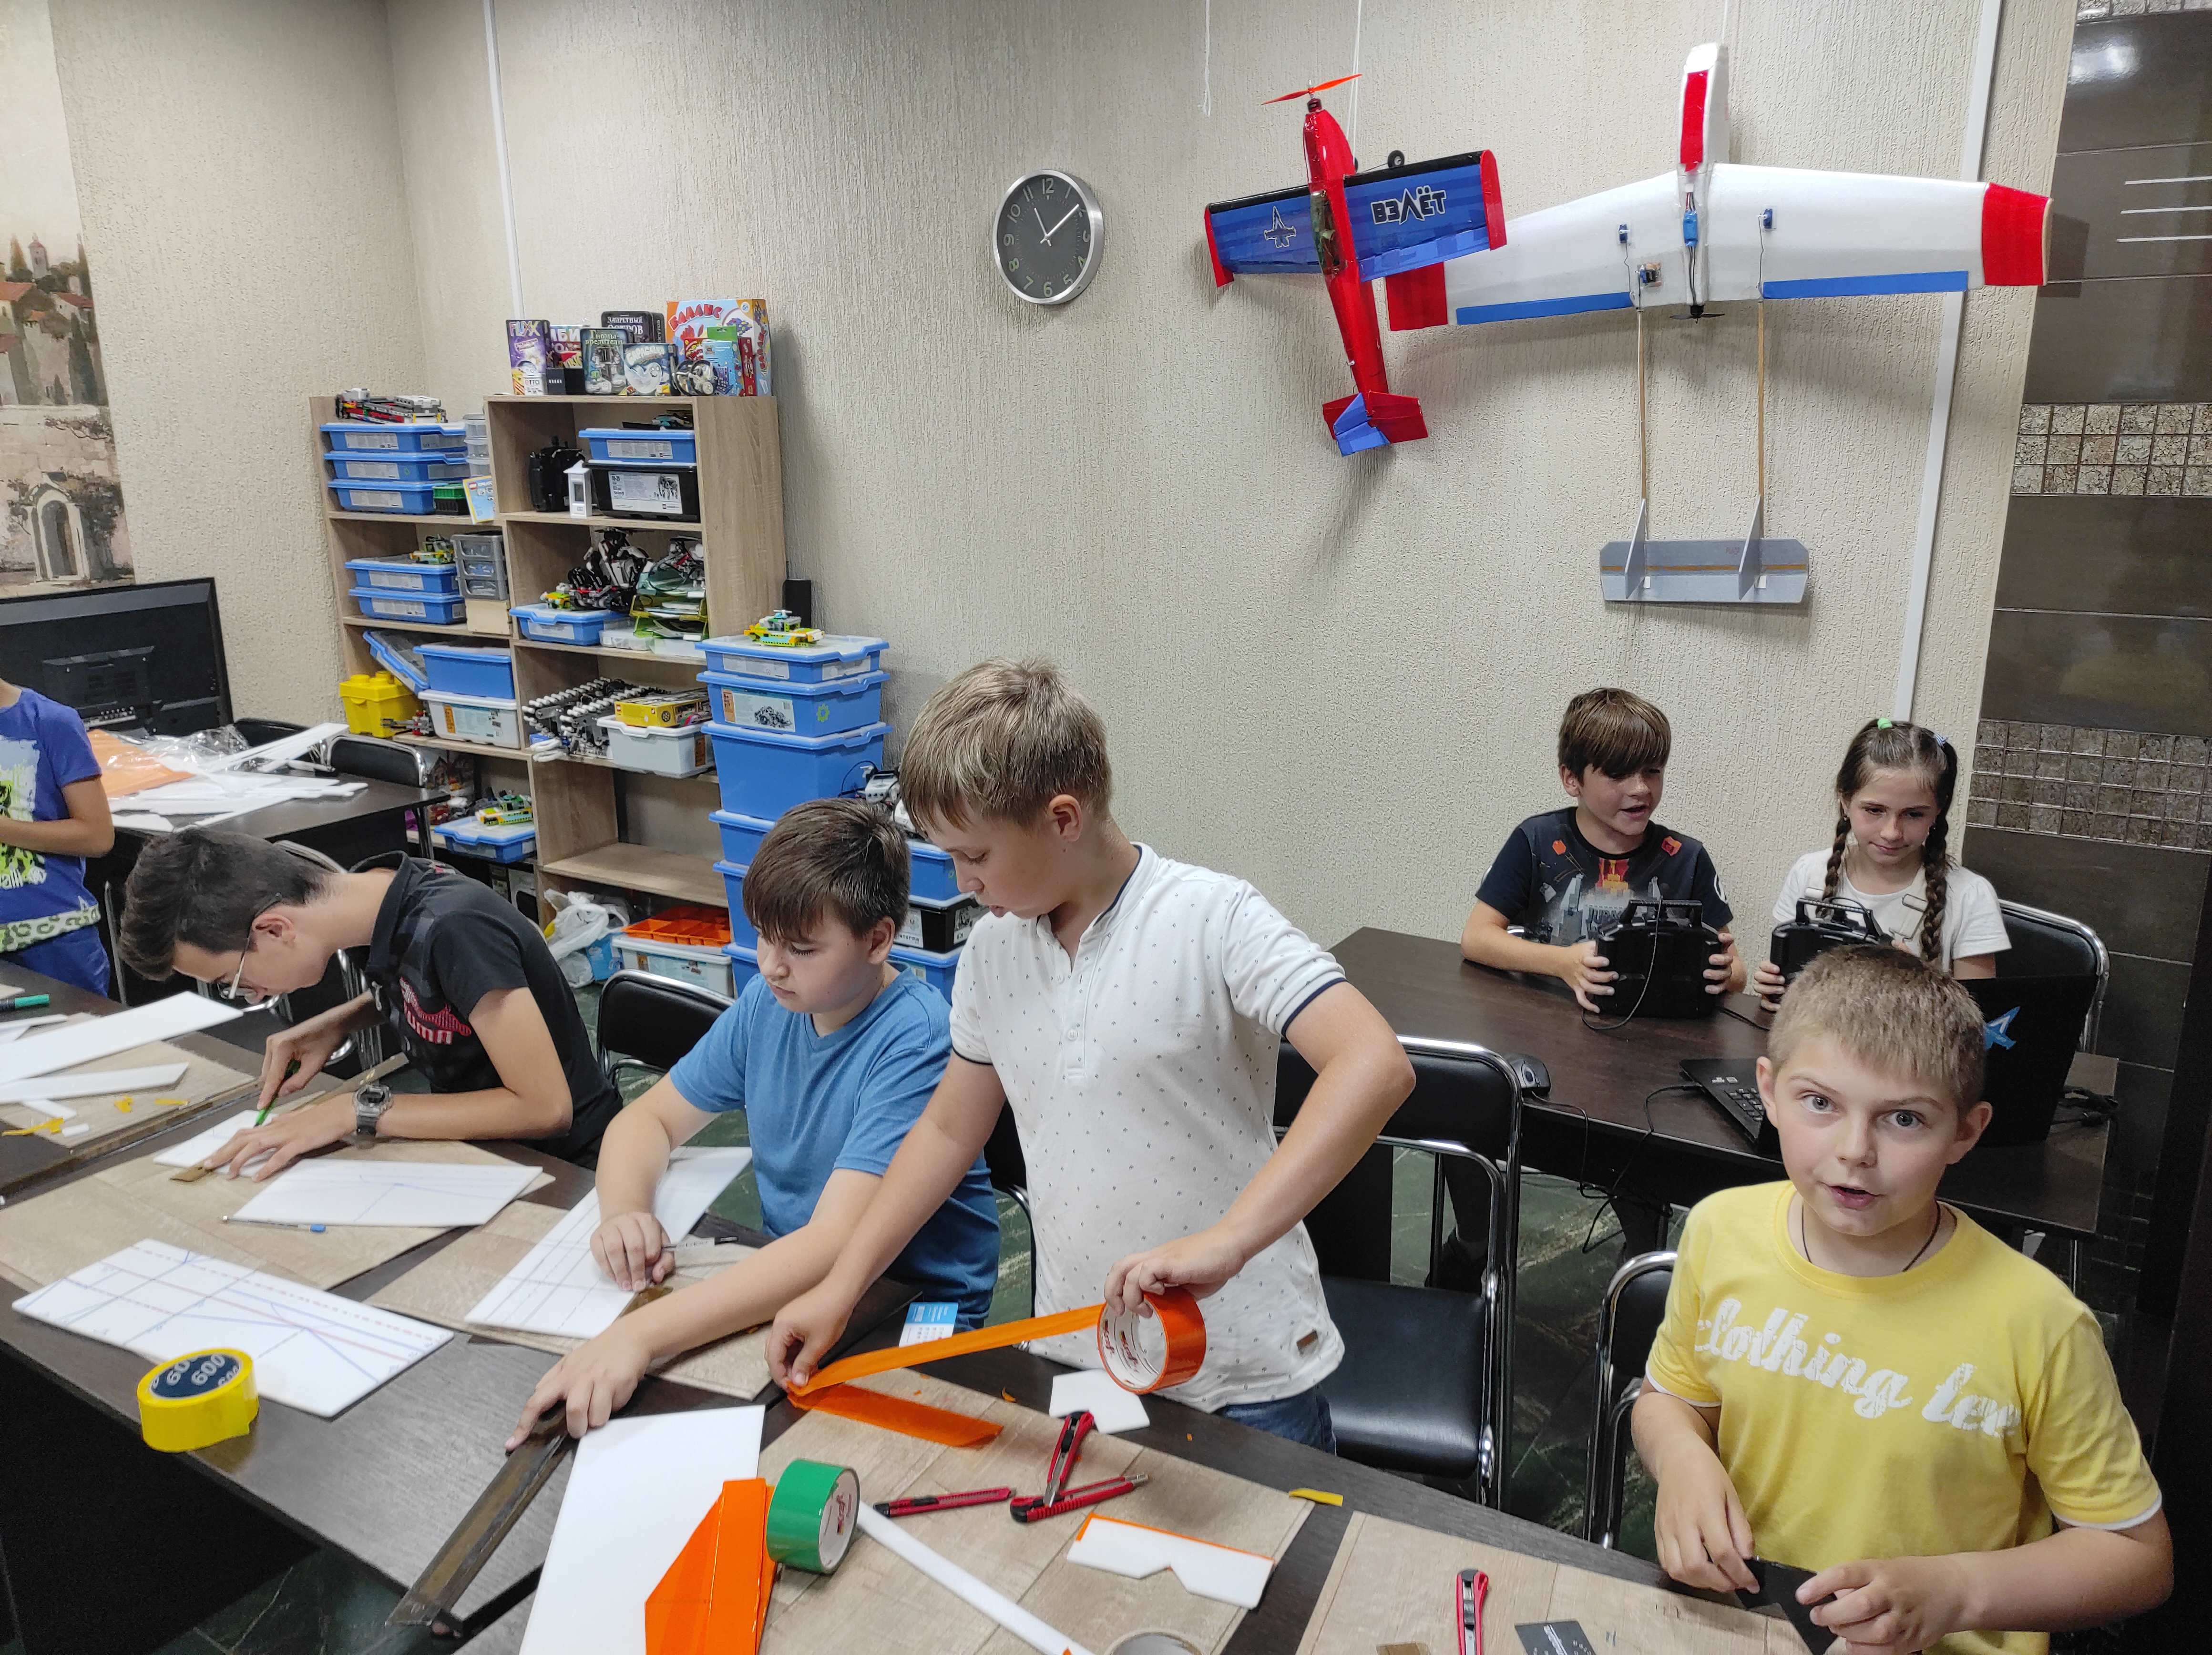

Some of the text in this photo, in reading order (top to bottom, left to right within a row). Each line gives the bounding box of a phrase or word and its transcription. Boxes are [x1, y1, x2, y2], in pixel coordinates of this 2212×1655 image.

[1042, 177, 1055, 194] 12
[1371, 185, 1446, 225] ВЗЛЁТ
[1043, 281, 1053, 297] 6
[669, 303, 723, 331] БАЛАНС
[509, 321, 541, 337] FLUXX
[192, 1354, 225, 1386] 600
